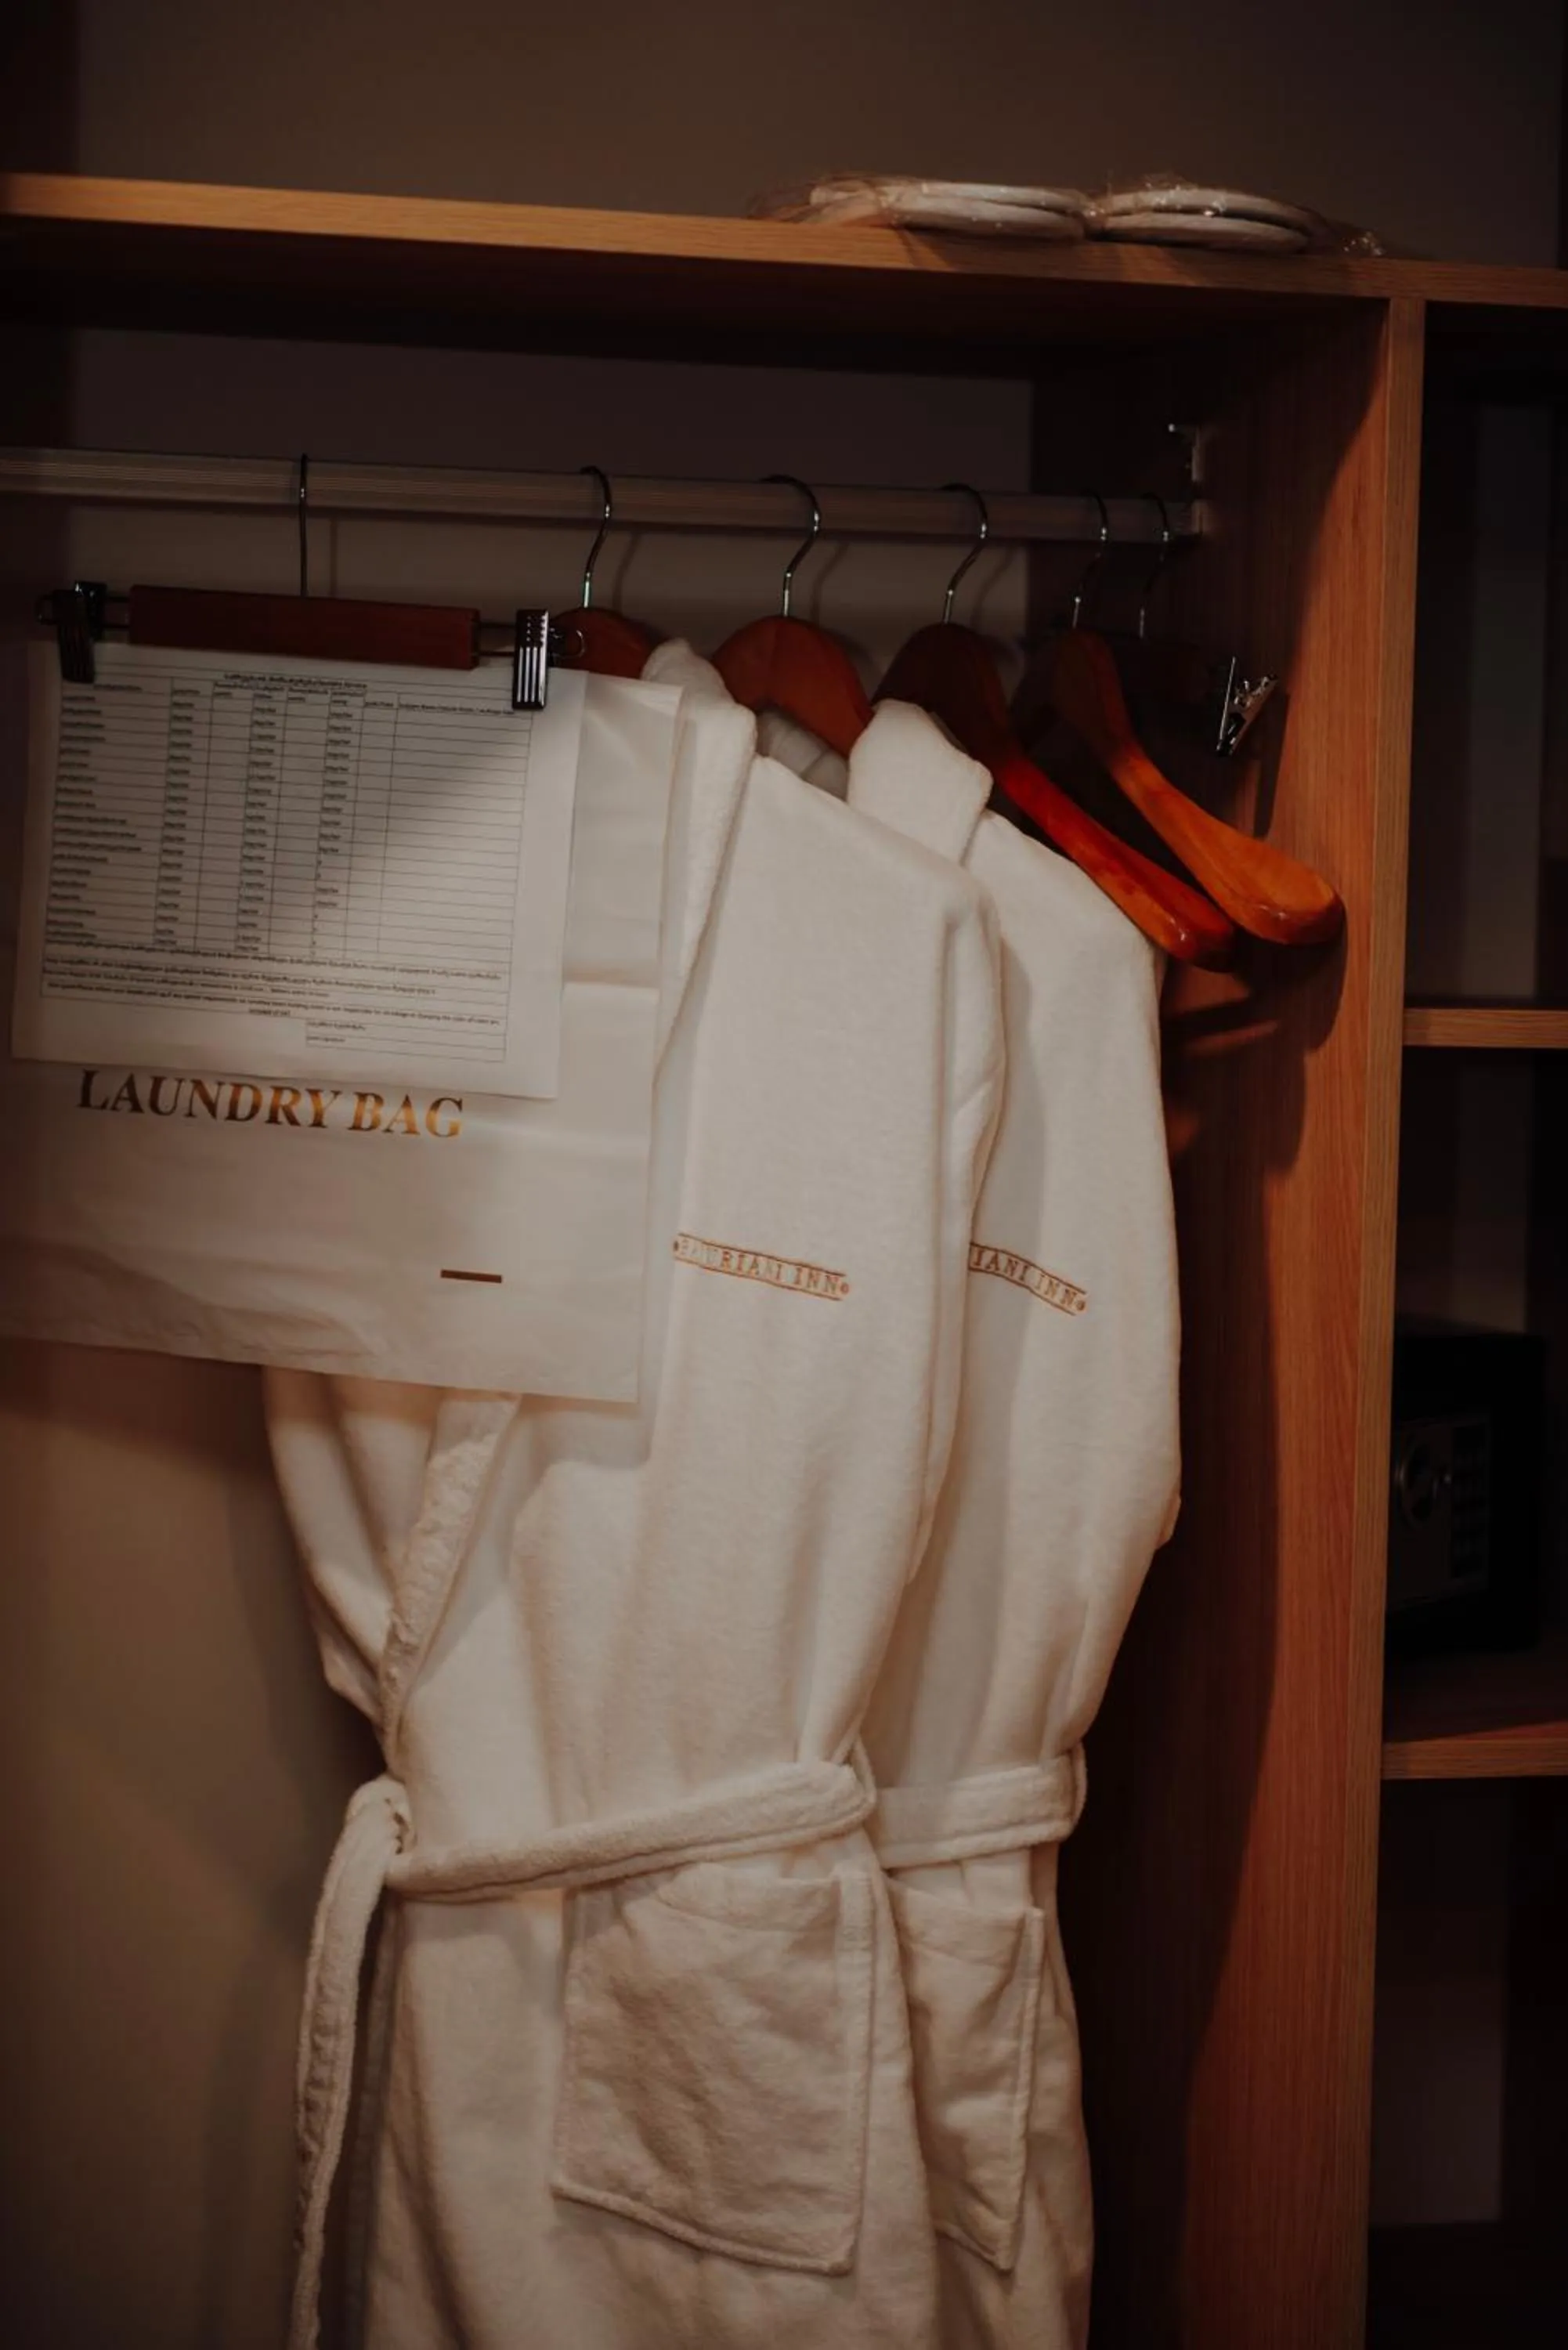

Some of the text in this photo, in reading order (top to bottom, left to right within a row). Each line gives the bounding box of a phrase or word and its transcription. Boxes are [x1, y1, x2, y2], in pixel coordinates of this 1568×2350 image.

[76, 1068, 464, 1138] LAUNDRY BAG
[794, 1267, 838, 1295] INN
[1035, 1273, 1078, 1306] INN
